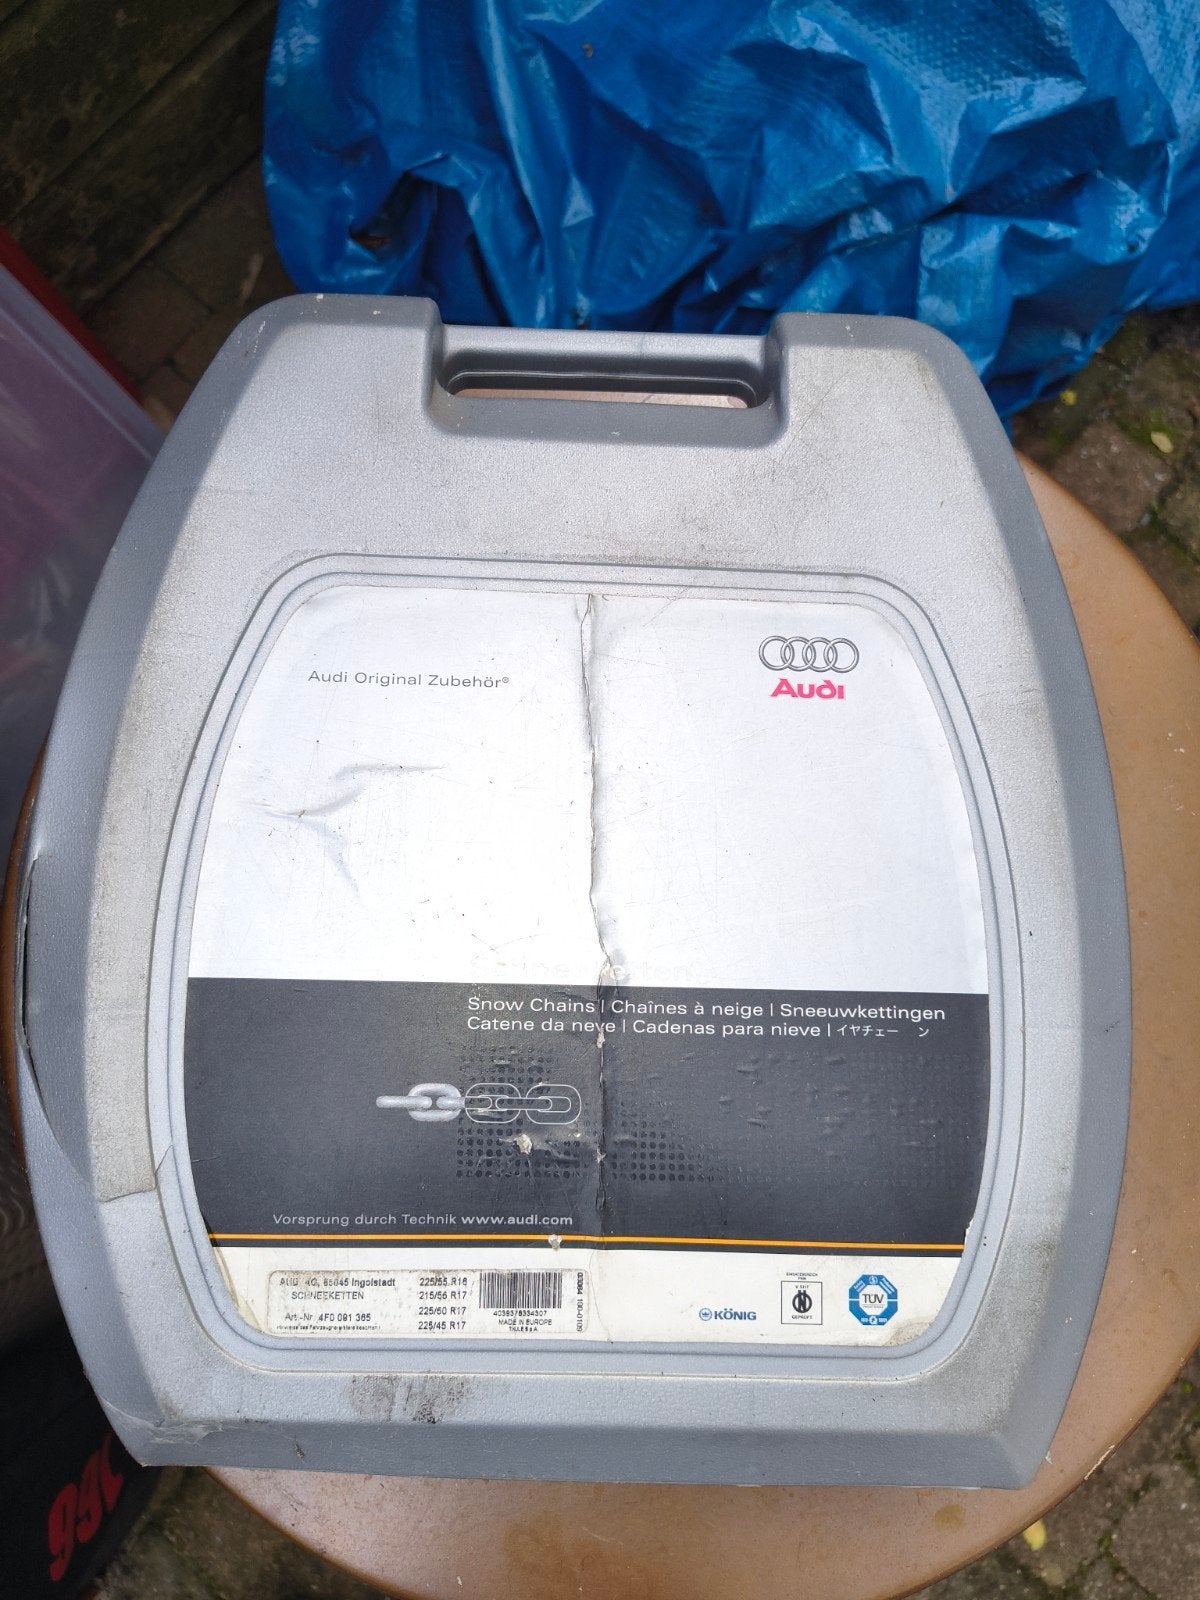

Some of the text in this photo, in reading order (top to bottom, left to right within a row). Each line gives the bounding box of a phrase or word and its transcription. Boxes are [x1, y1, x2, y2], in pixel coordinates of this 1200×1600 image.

[308, 671, 348, 683] Audi
[355, 672, 421, 687] Original
[770, 678, 845, 699] Audi
[468, 997, 946, 1022] Snow Chains Chaînes à neige Sneeuwkettingen
[467, 1016, 821, 1038] Catene da neve Cadenas para nieve
[273, 1213, 573, 1227] Vorsprung durch Technik www.audi.com
[351, 1277, 396, 1288] Ingolstadt
[450, 1290, 467, 1300] R17
[862, 1293, 884, 1303] TÜV
[450, 1306, 466, 1315] R17
[714, 1308, 757, 1321] KÖNIG
[450, 1320, 466, 1330] R17
